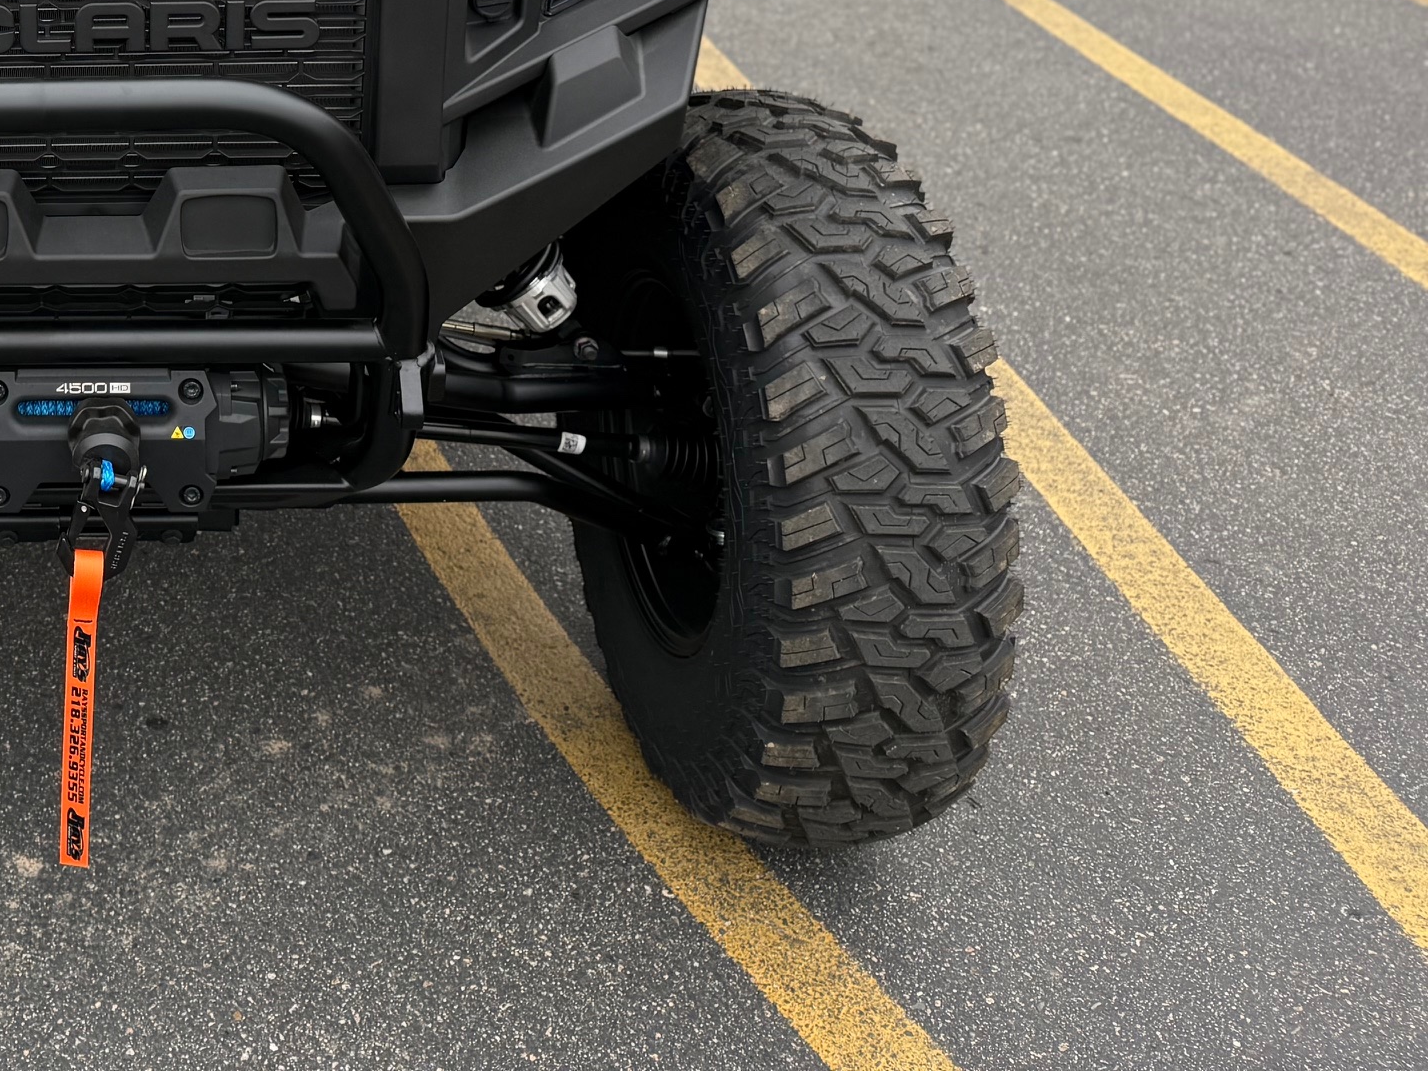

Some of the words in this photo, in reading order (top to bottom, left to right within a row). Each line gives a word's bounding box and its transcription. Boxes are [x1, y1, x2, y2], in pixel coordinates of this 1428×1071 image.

[56, 382, 108, 394] 4500
[111, 383, 130, 393] HD
[68, 686, 82, 802] 218.326.9355
[78, 688, 89, 804] RAYSSPORTANDCYCLE.COM
